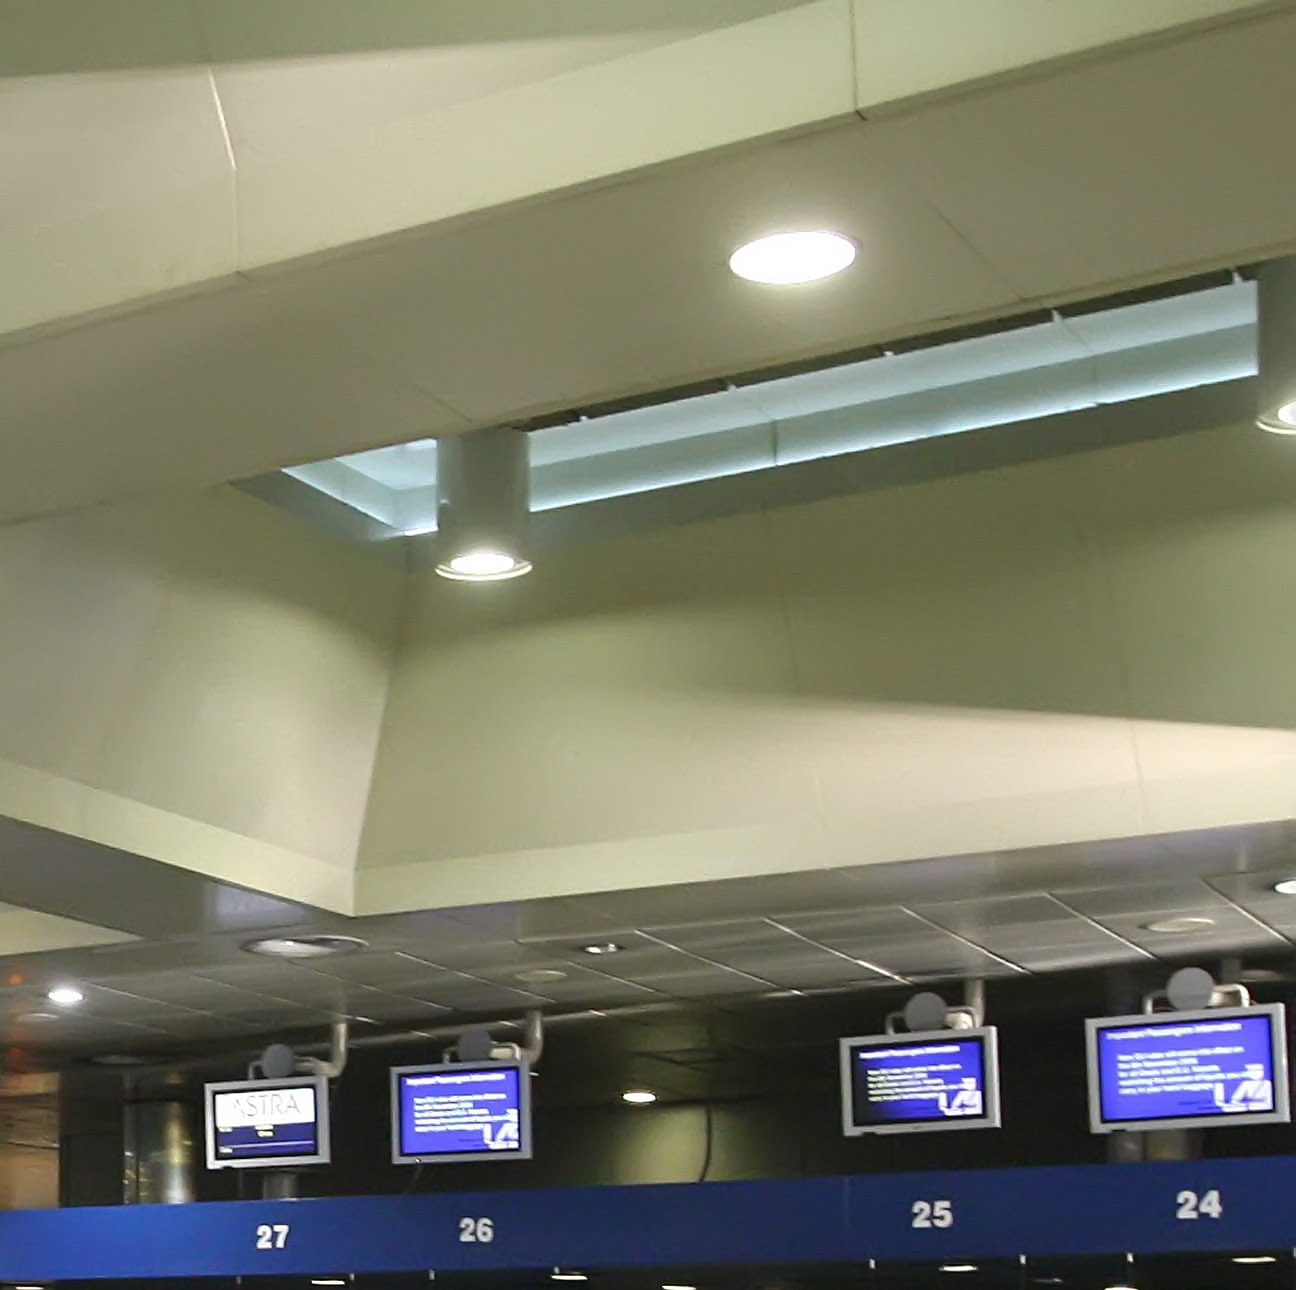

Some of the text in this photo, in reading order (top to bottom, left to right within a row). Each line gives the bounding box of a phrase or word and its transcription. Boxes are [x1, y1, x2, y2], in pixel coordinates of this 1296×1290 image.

[232, 1093, 300, 1117] ASTRA
[911, 1200, 954, 1228] 25
[1176, 1190, 1223, 1218] 24
[256, 1224, 289, 1249] 27
[459, 1217, 494, 1242] 26
